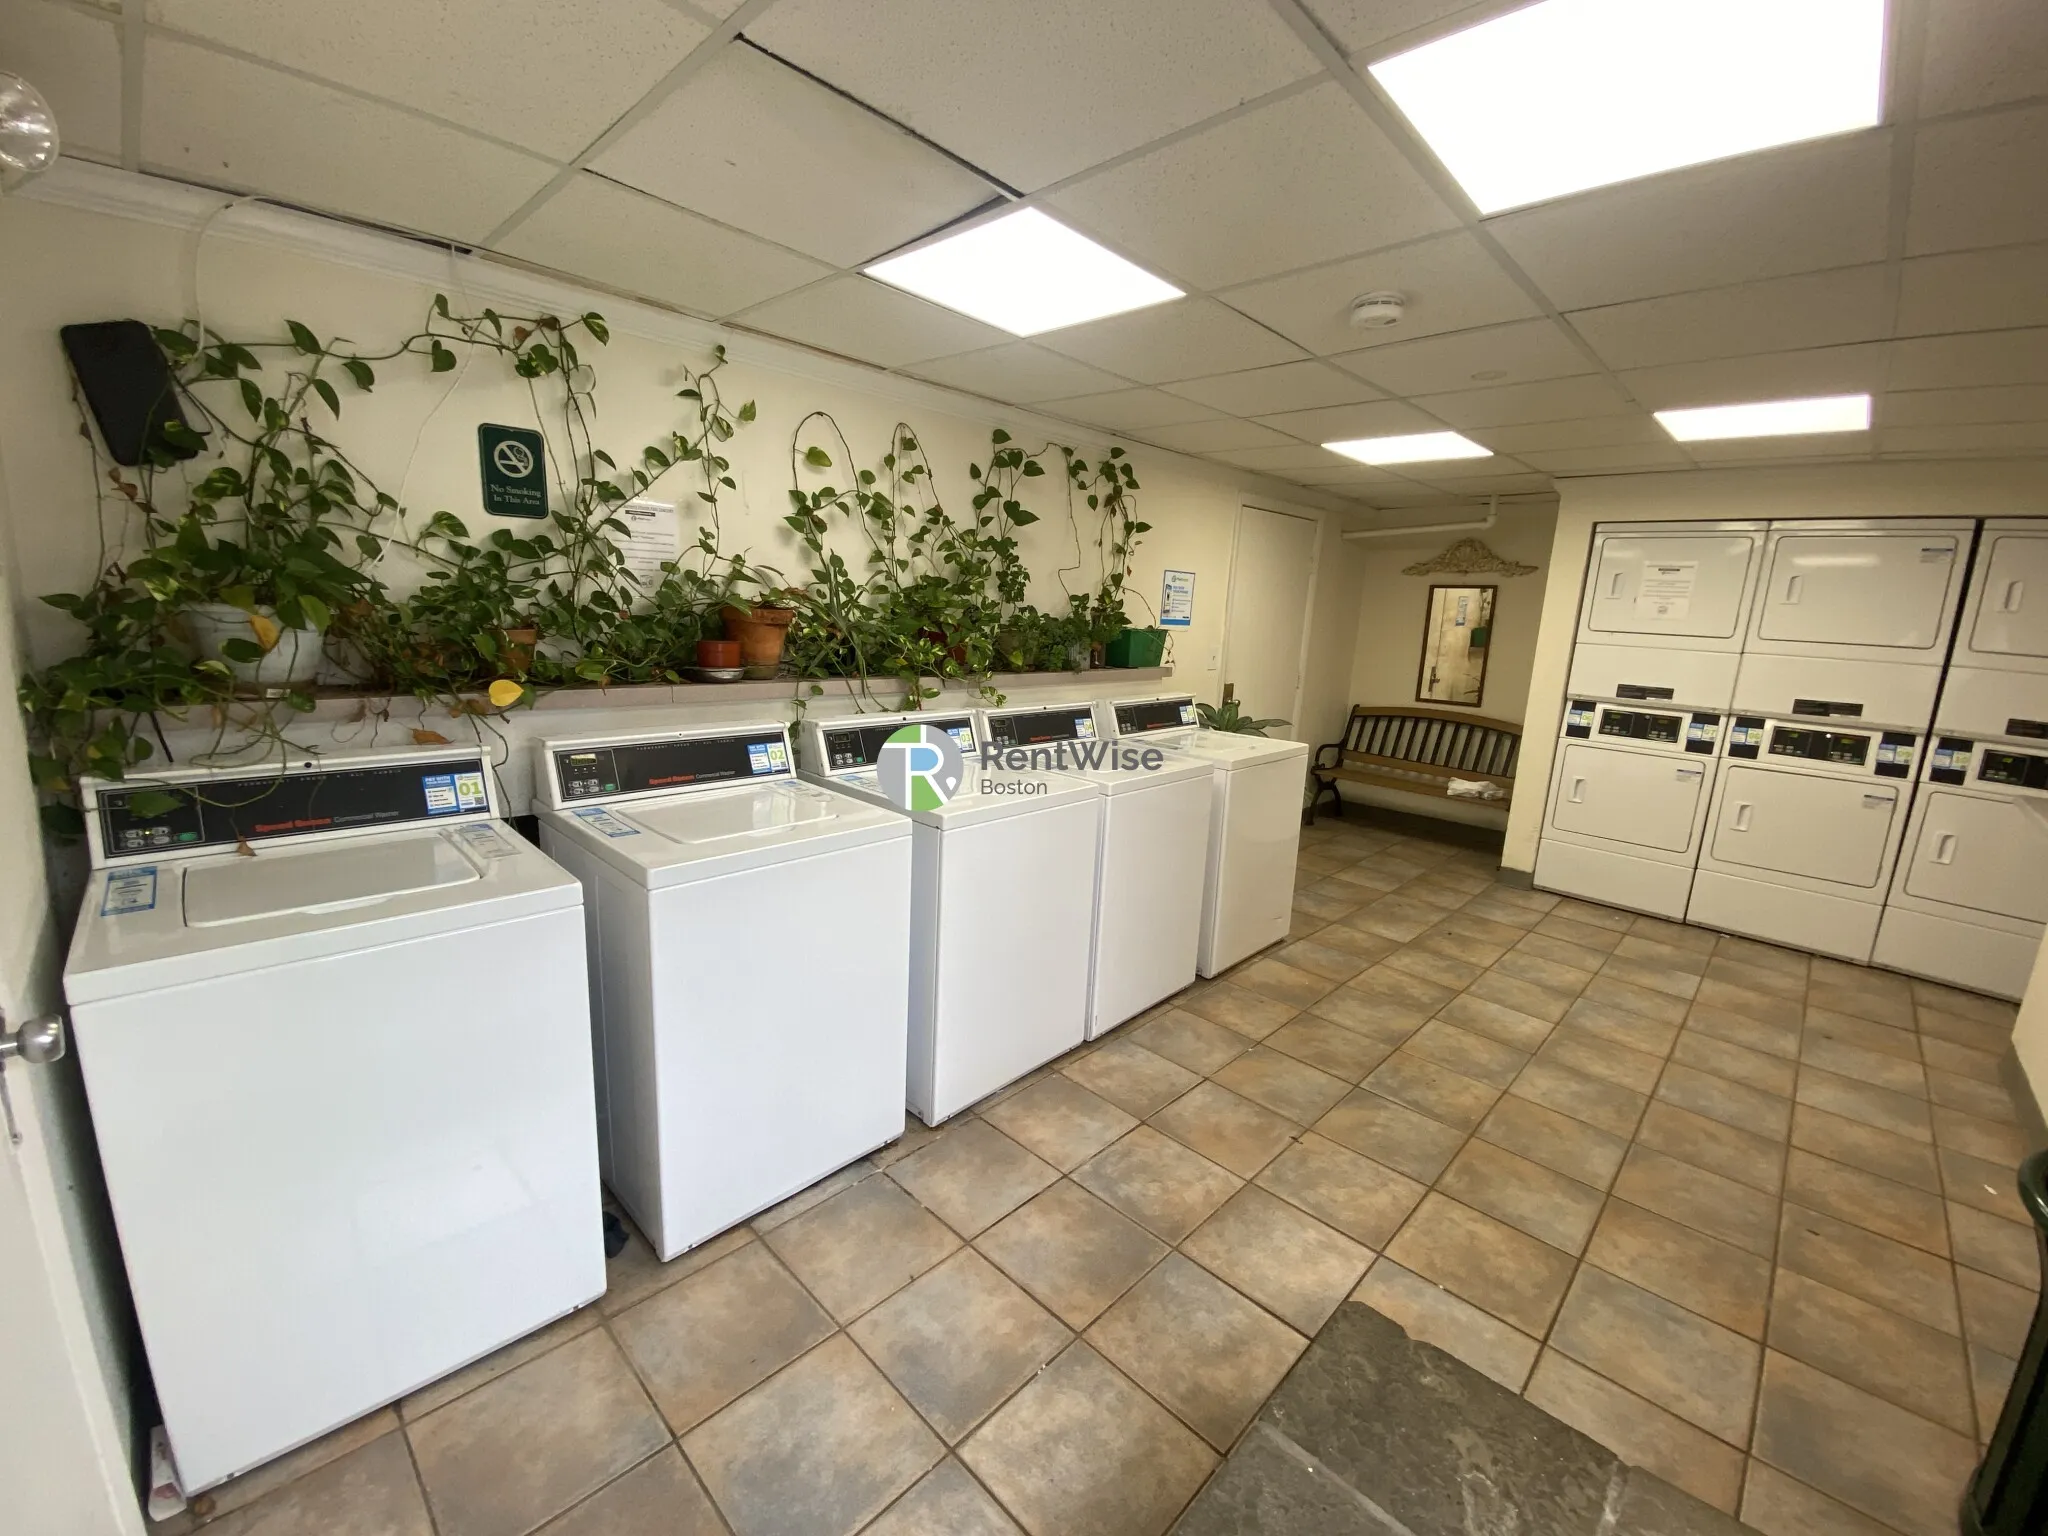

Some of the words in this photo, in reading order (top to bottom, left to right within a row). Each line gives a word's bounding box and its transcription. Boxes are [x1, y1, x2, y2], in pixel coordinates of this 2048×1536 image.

[490, 484, 504, 492] No
[506, 485, 541, 498] Smoking
[493, 494, 502, 502] In
[523, 497, 540, 505] Area
[770, 750, 785, 761] 02
[459, 782, 482, 795] 01
